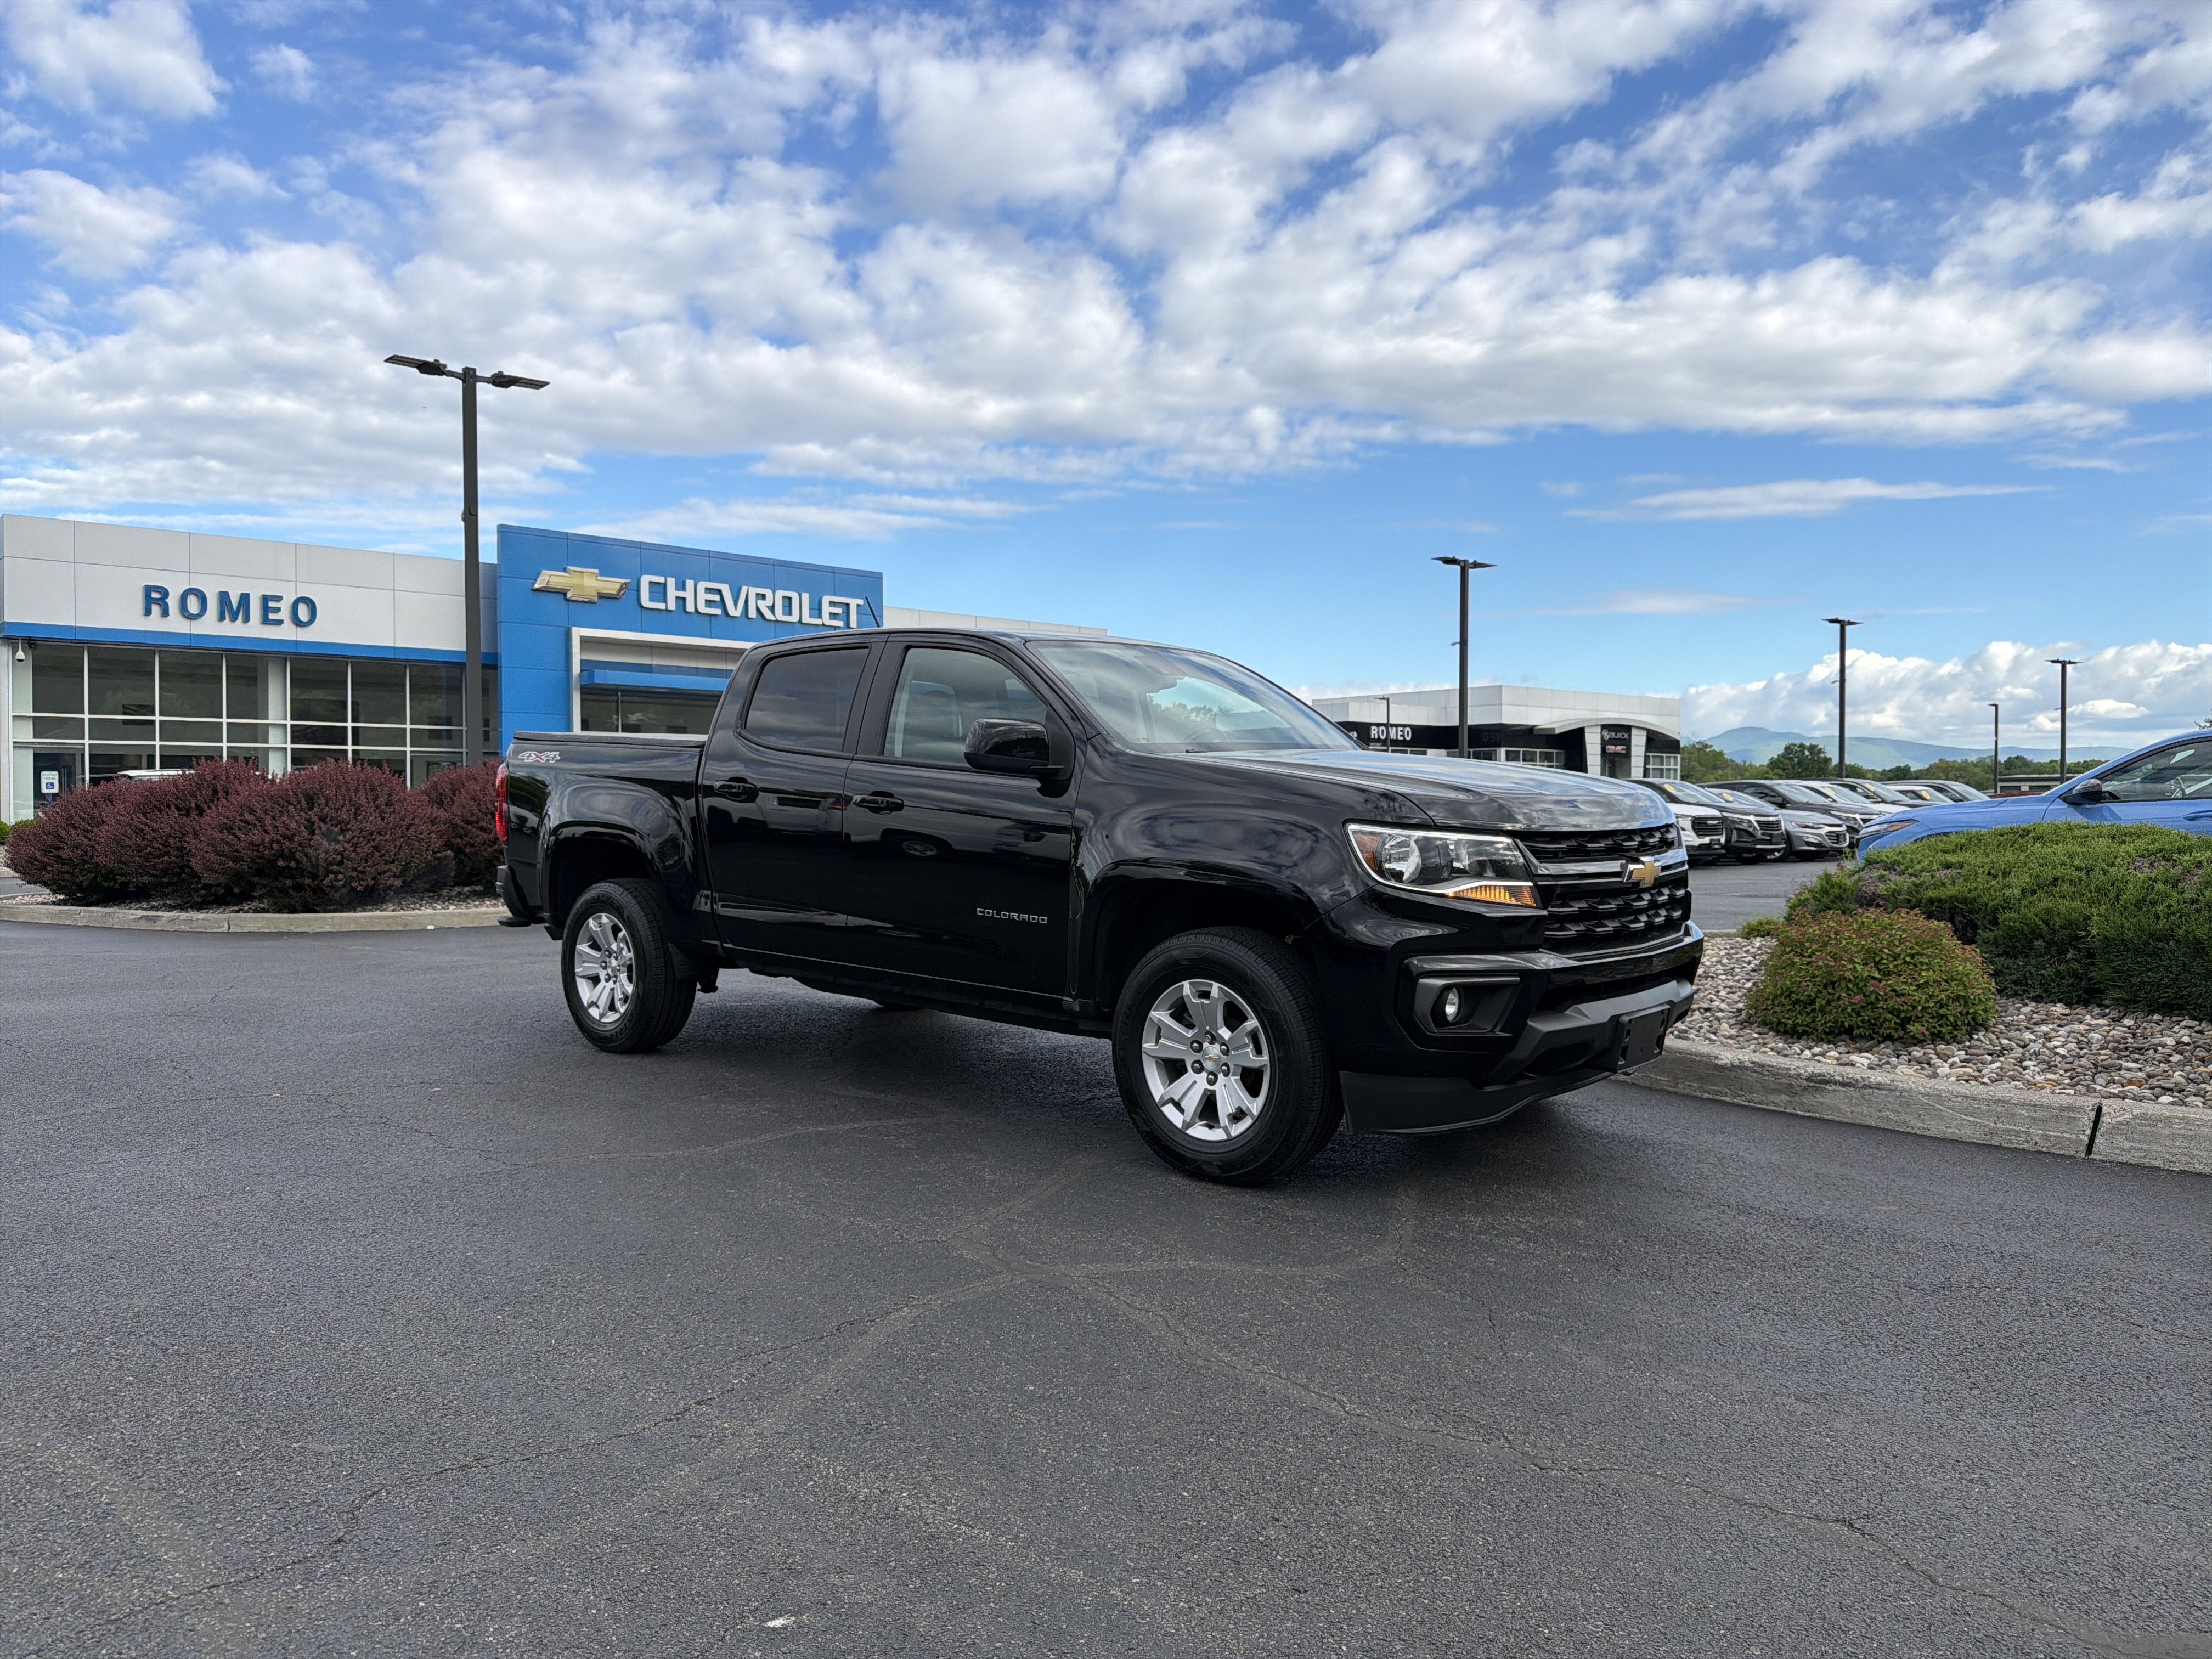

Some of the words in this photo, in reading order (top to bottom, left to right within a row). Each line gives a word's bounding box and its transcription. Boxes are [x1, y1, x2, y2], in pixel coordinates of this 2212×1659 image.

[143, 584, 317, 627] ROMEO
[640, 575, 864, 628] CHEVROLET
[1369, 725, 1412, 741] ROMEO
[1609, 731, 1629, 740] BUICK
[1605, 745, 1627, 754] GMC
[977, 908, 1048, 924] COLORADO
